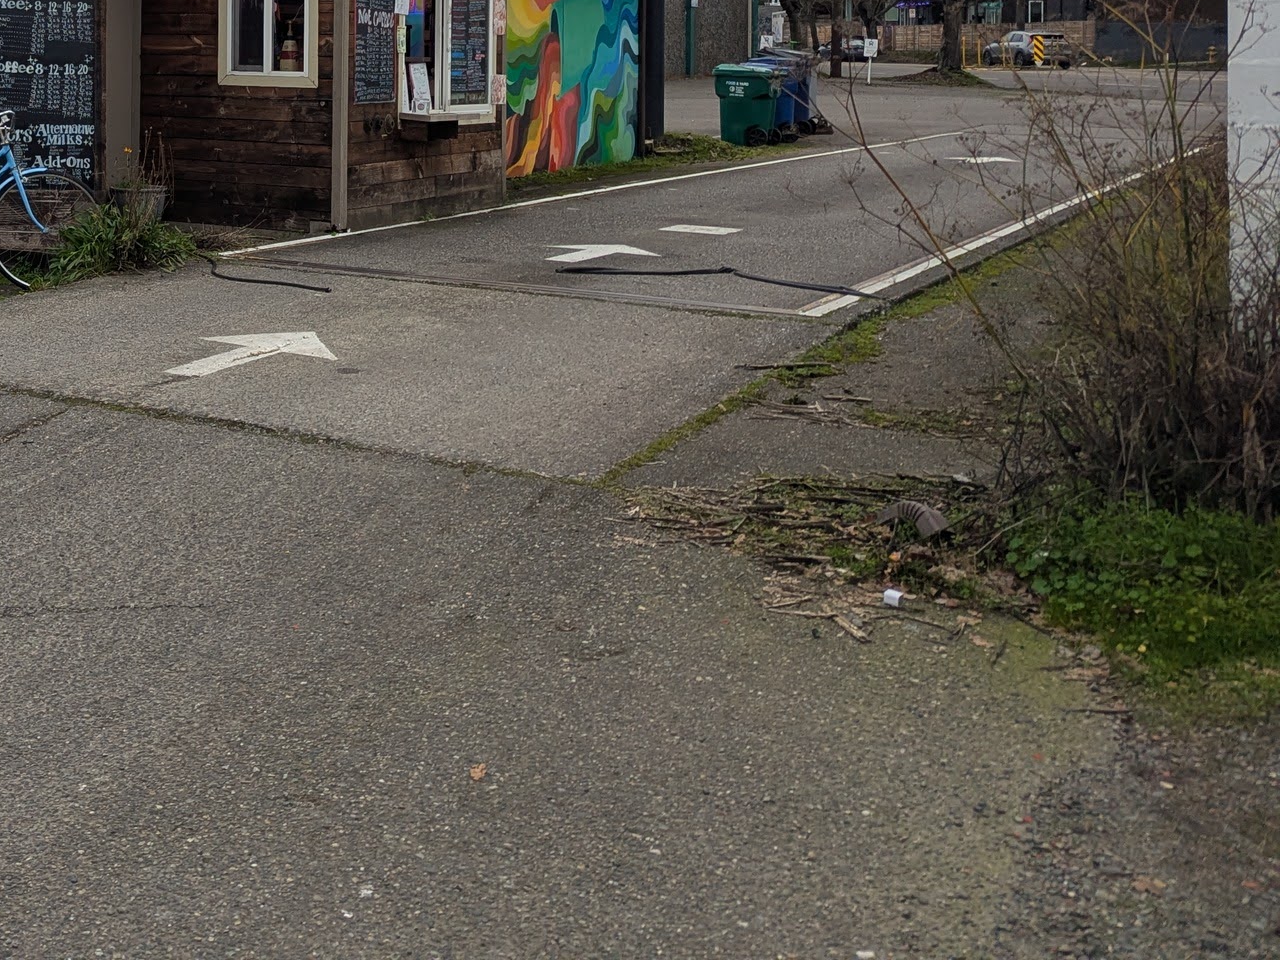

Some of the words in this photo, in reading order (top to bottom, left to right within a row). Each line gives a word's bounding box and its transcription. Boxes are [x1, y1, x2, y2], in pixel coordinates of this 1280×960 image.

[36, 124, 95, 136] Alternative
[46, 134, 83, 146] Milks
[32, 155, 90, 169] Add-Ons
